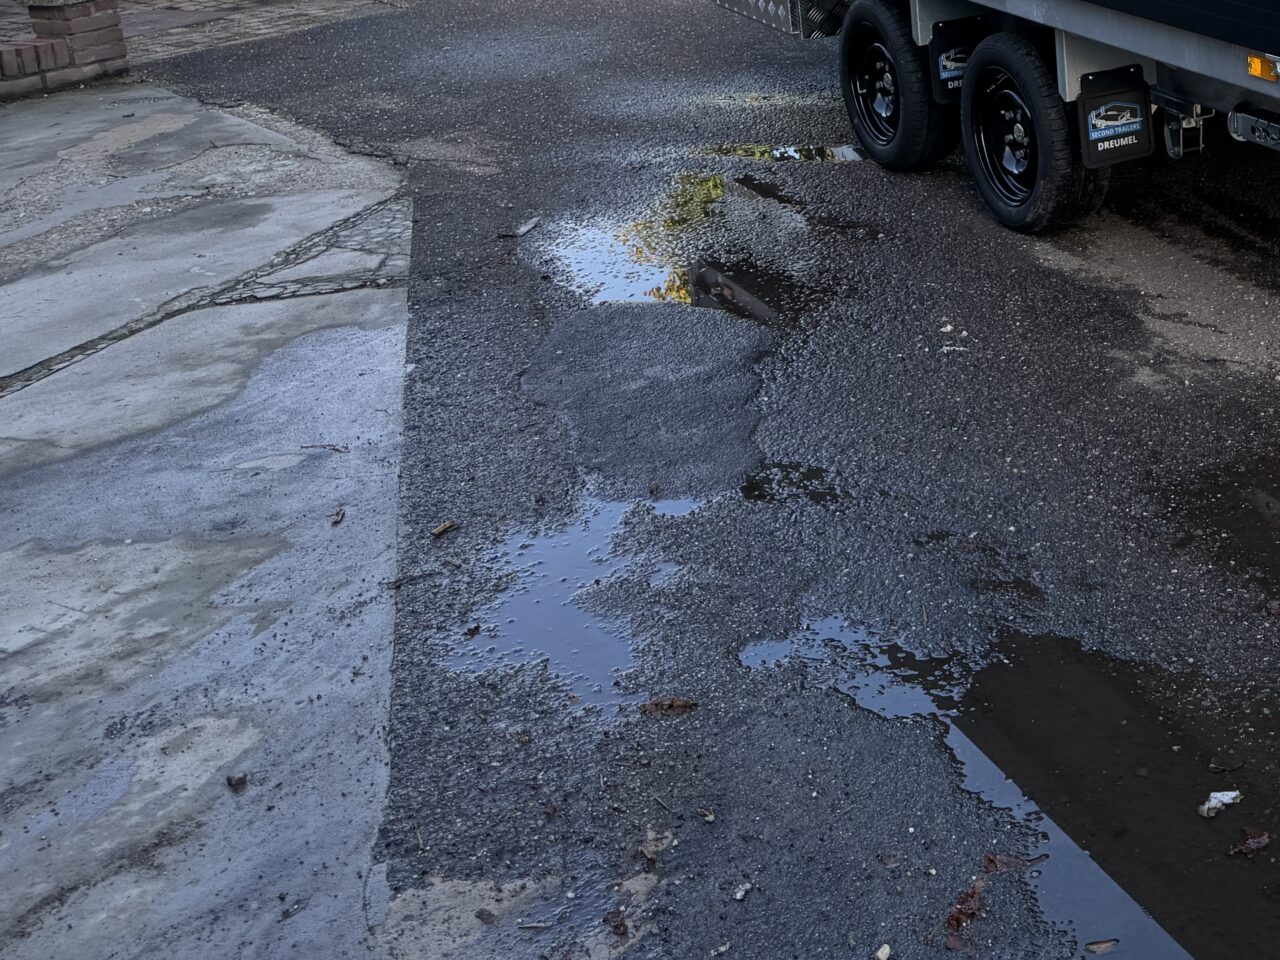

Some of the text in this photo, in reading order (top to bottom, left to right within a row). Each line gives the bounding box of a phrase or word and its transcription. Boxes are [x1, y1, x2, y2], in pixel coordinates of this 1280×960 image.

[1091, 123, 1140, 138] SECOND TRAILERS
[1098, 135, 1138, 151] DREUMEL
